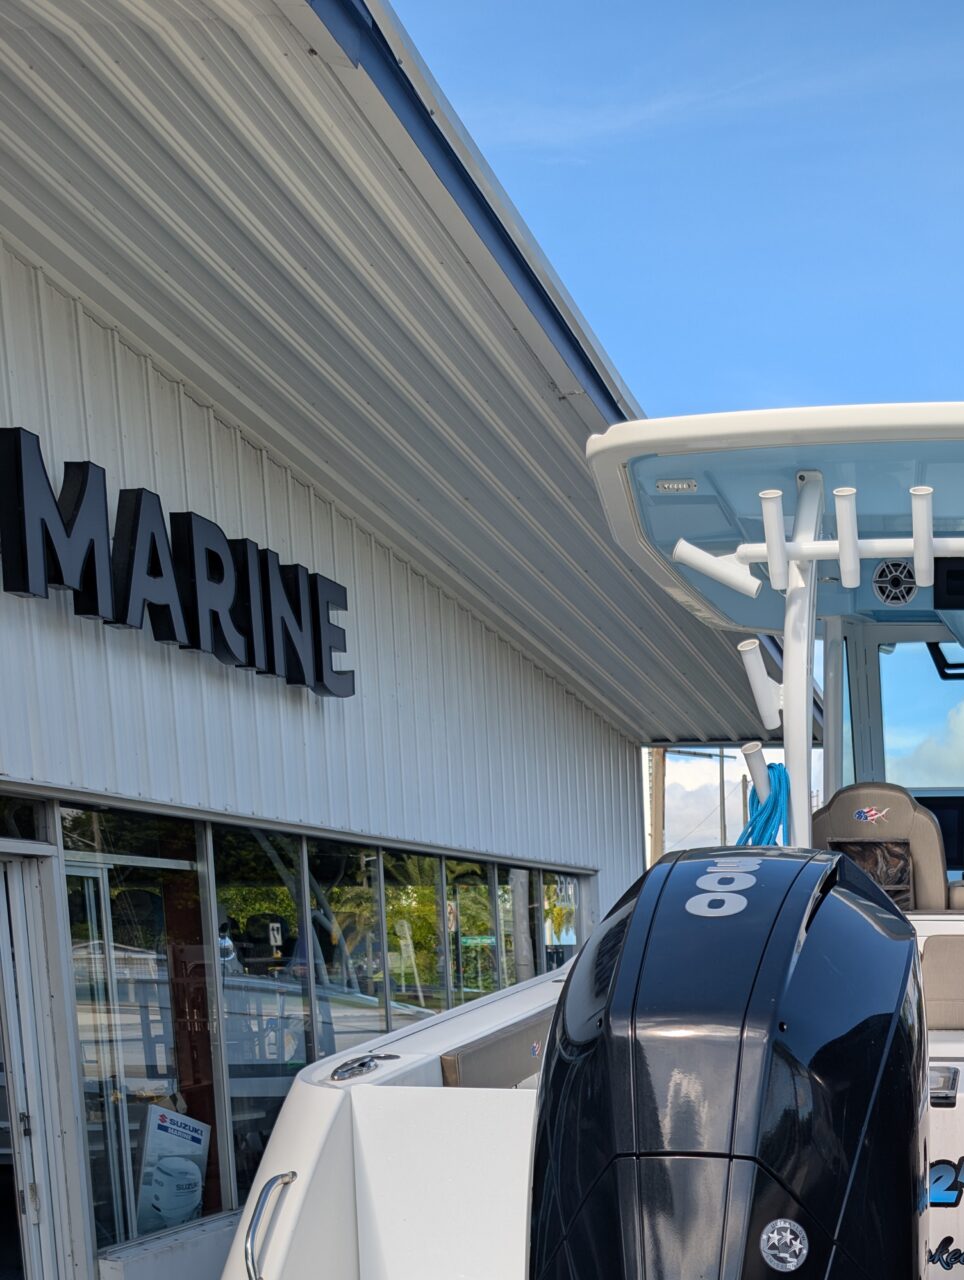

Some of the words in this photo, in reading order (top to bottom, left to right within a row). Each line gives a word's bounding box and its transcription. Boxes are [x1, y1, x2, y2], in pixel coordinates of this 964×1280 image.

[0, 427, 355, 698] MARINE
[168, 1127, 192, 1141] MARINE
[169, 1118, 204, 1137] SUZUKI
